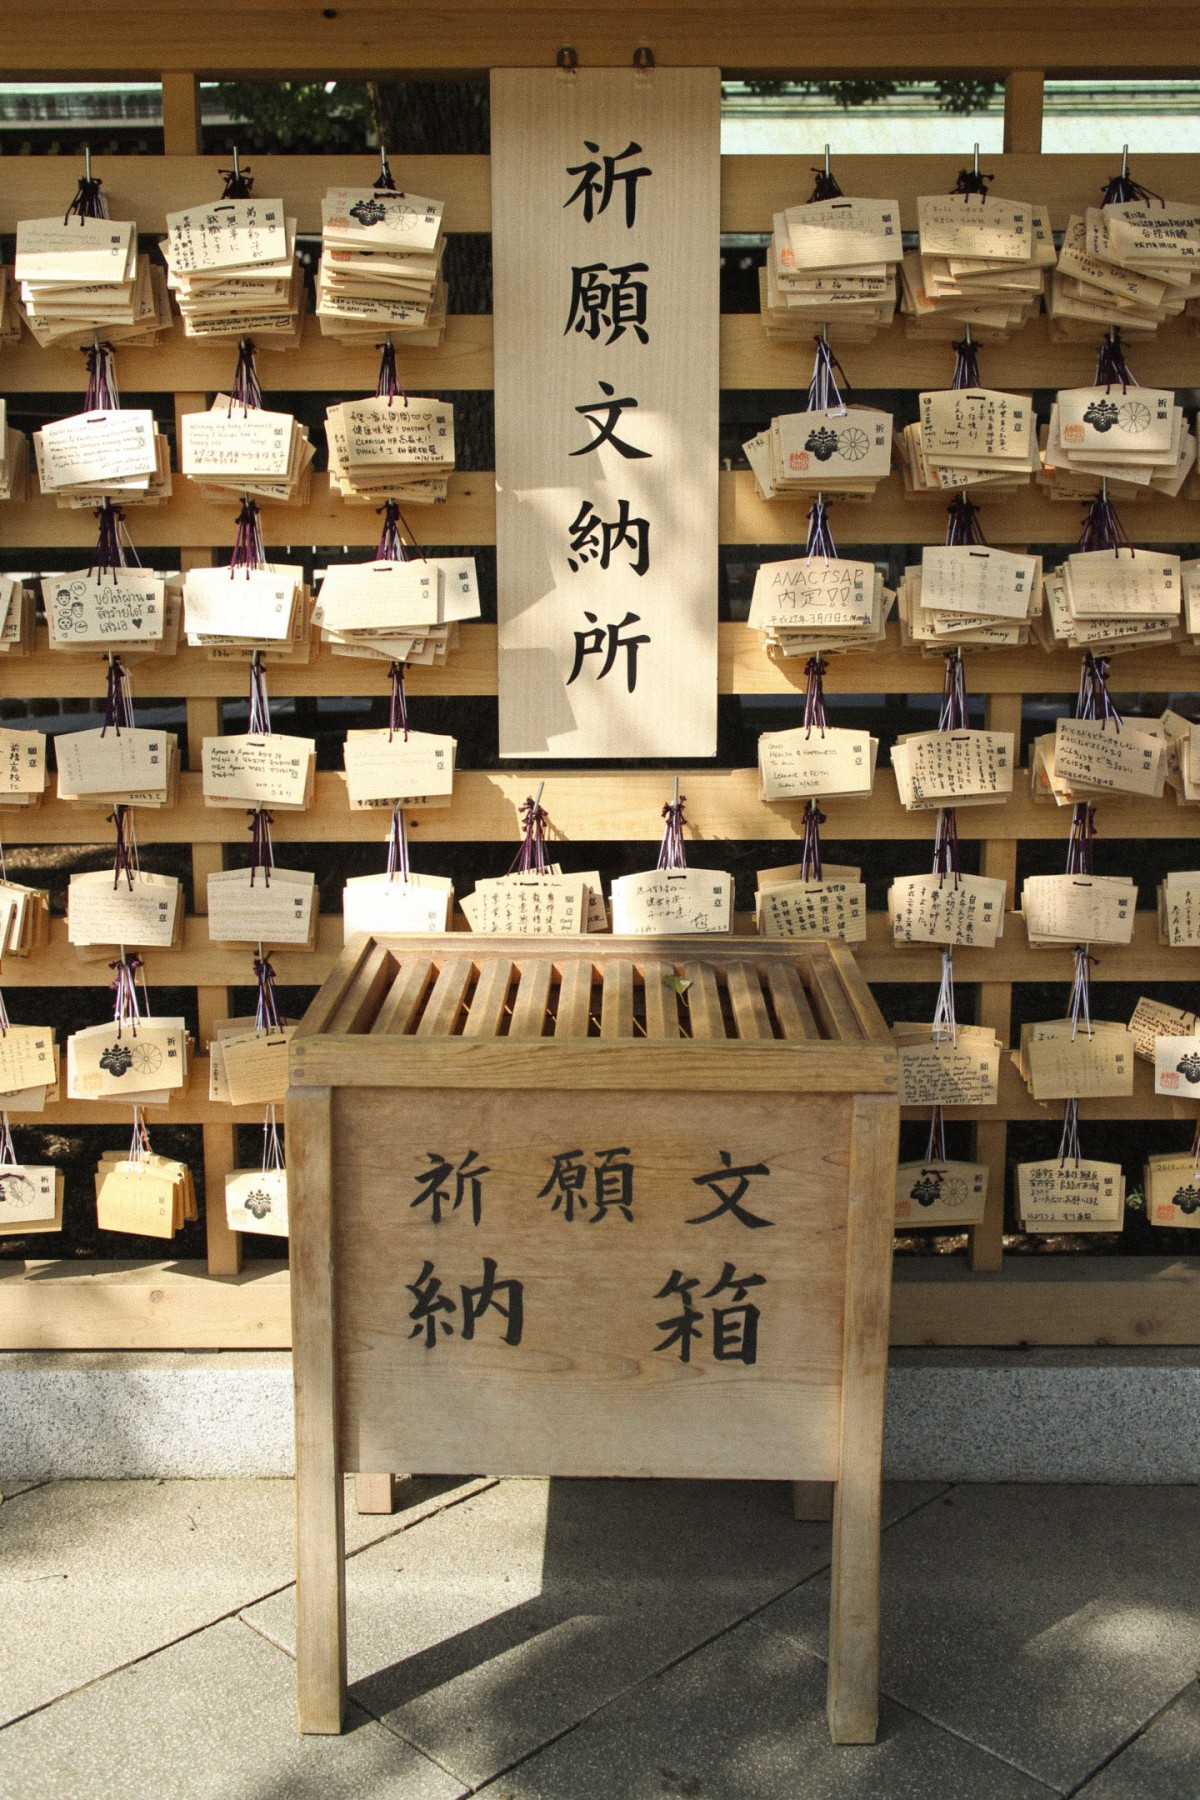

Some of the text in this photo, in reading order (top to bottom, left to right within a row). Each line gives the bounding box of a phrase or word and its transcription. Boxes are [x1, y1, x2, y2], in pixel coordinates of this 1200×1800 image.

[562, 140, 653, 694] 祈願文納所
[875, 424, 885, 446] 祈願
[1157, 399, 1167, 420] 祈願
[944, 890, 956, 931] 大切な人の
[409, 1147, 775, 1229] 祈願文
[406, 1257, 767, 1365] 納箱
